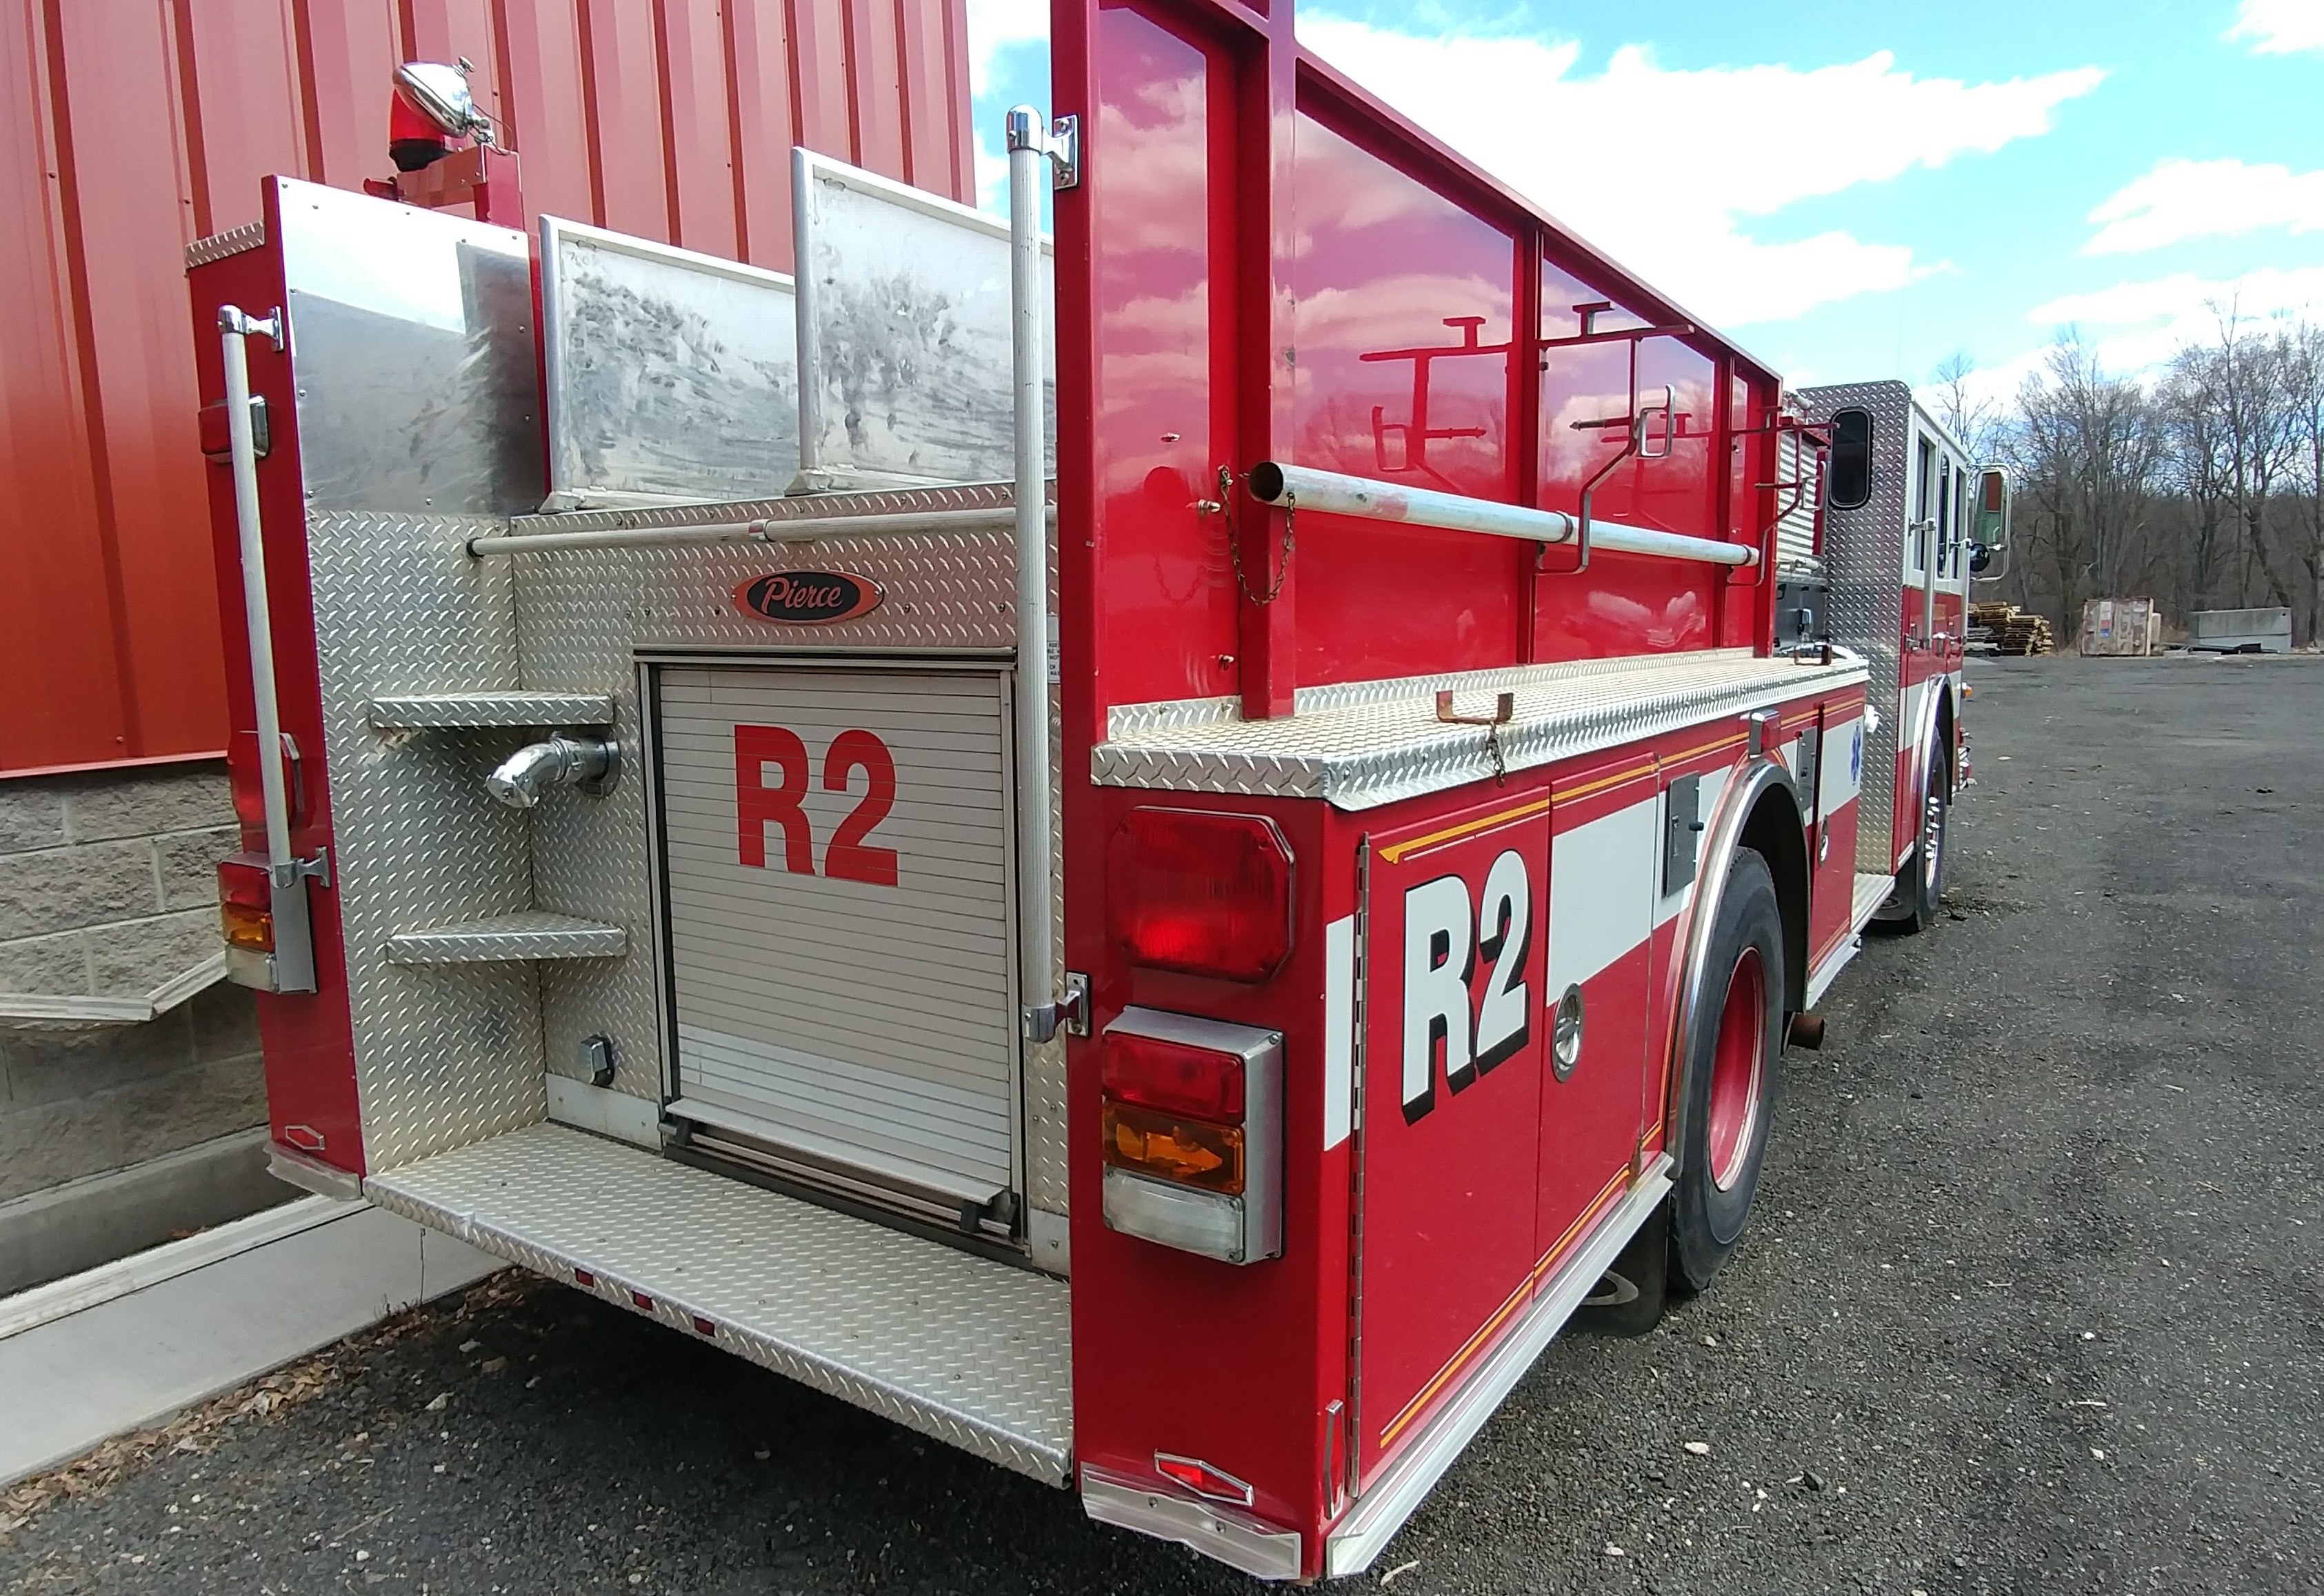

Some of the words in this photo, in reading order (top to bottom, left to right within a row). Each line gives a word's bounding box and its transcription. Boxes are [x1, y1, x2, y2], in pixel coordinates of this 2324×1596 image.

[761, 577, 843, 614] Pierce
[734, 724, 898, 887] R2
[1402, 849, 1532, 1127] R2
